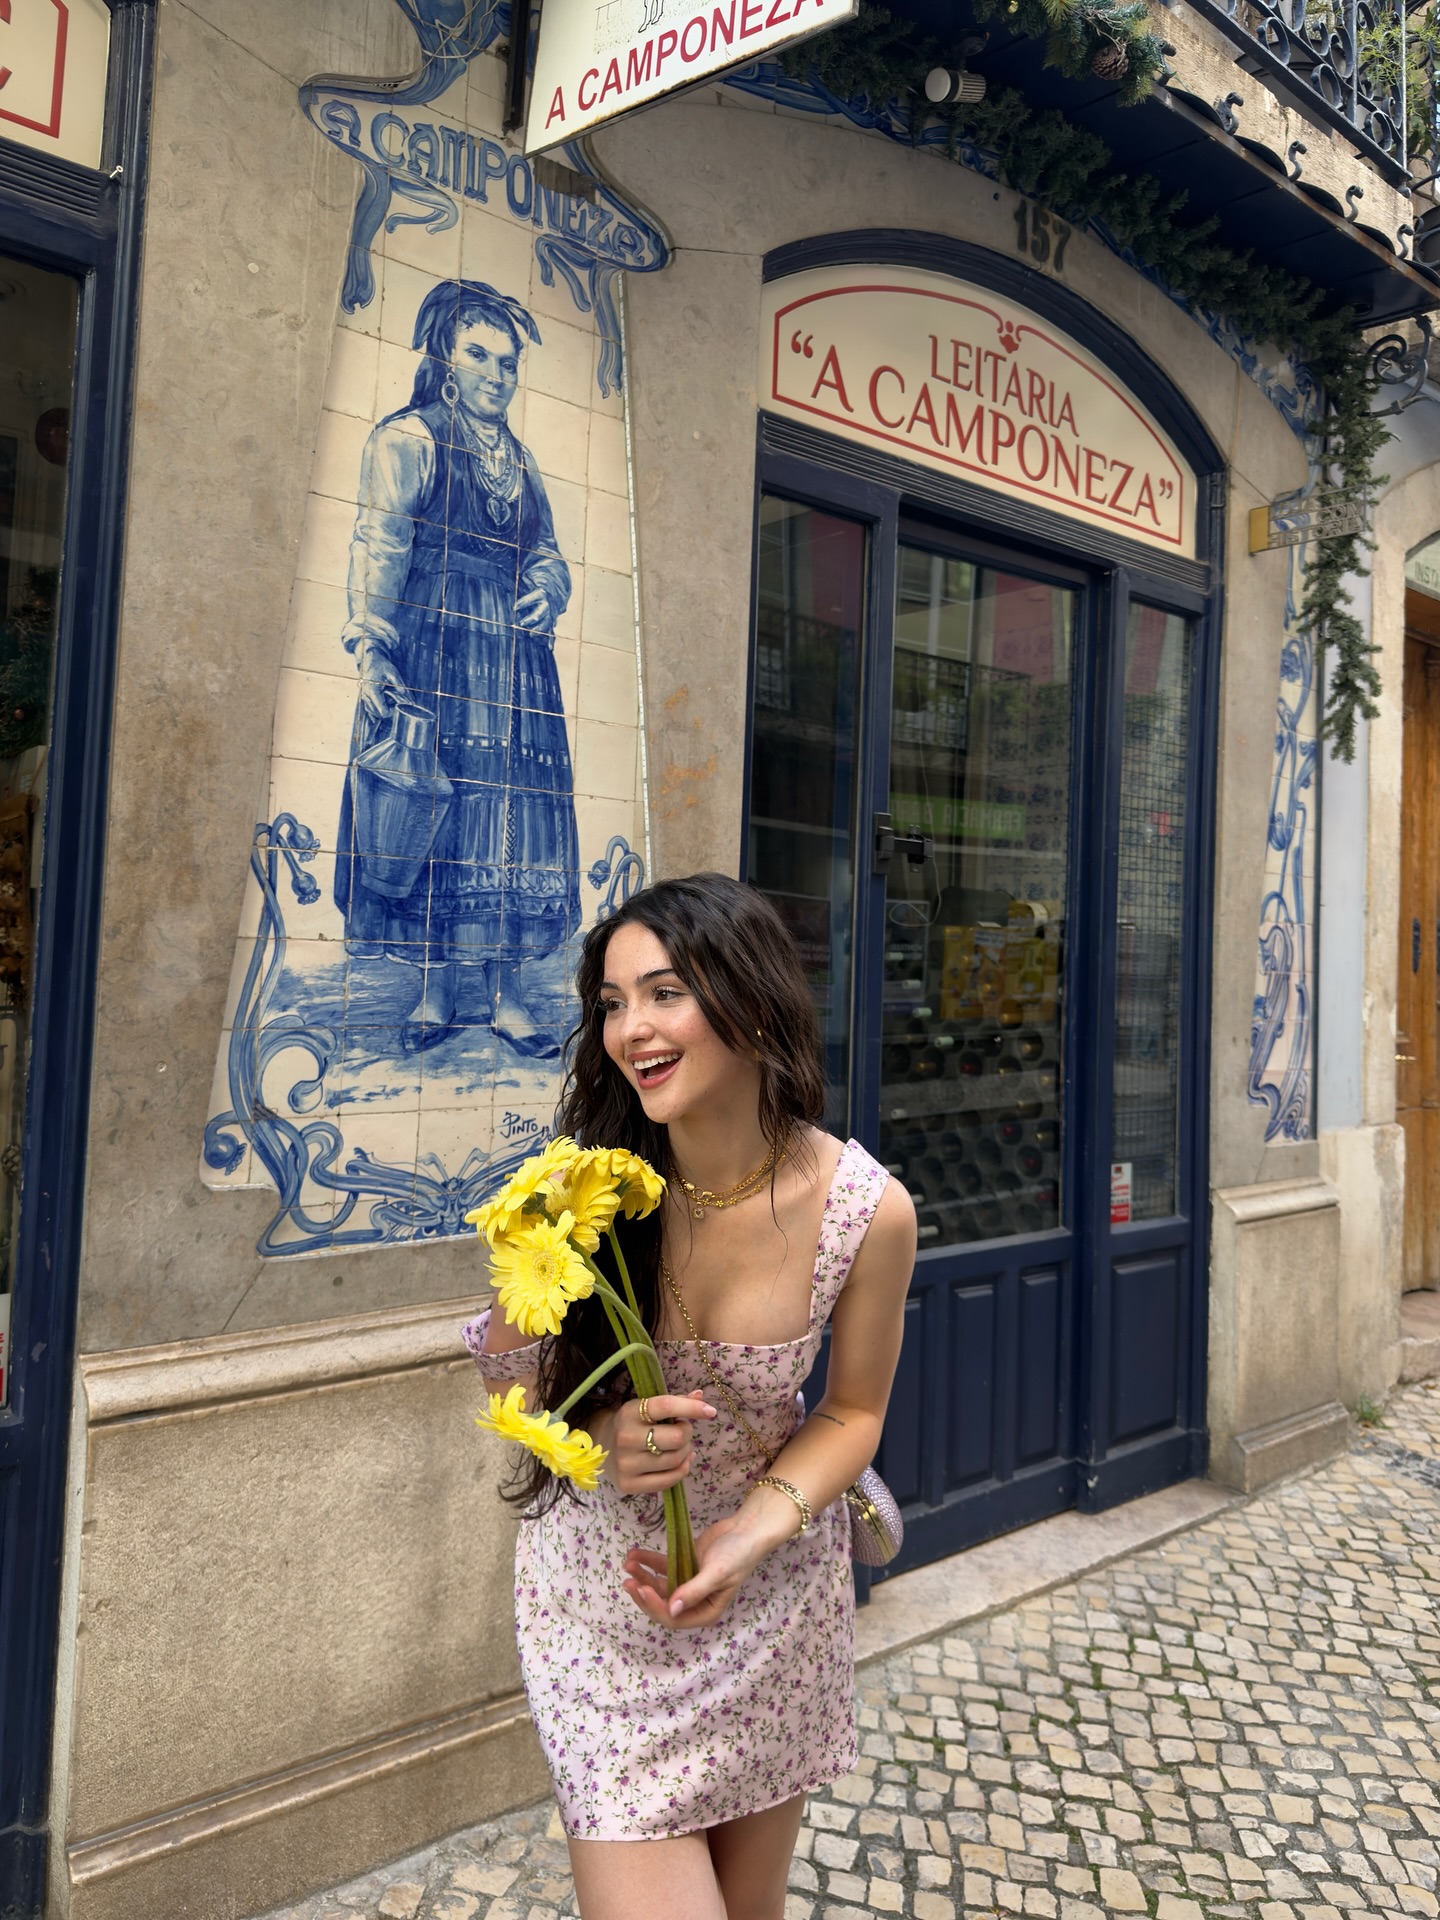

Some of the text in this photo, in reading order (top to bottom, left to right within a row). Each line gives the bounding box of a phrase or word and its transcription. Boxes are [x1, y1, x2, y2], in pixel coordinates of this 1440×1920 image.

[320, 99, 362, 149] A
[545, 85, 566, 130] A
[1014, 199, 1072, 272] 157
[928, 334, 1080, 438] LEITARIA
